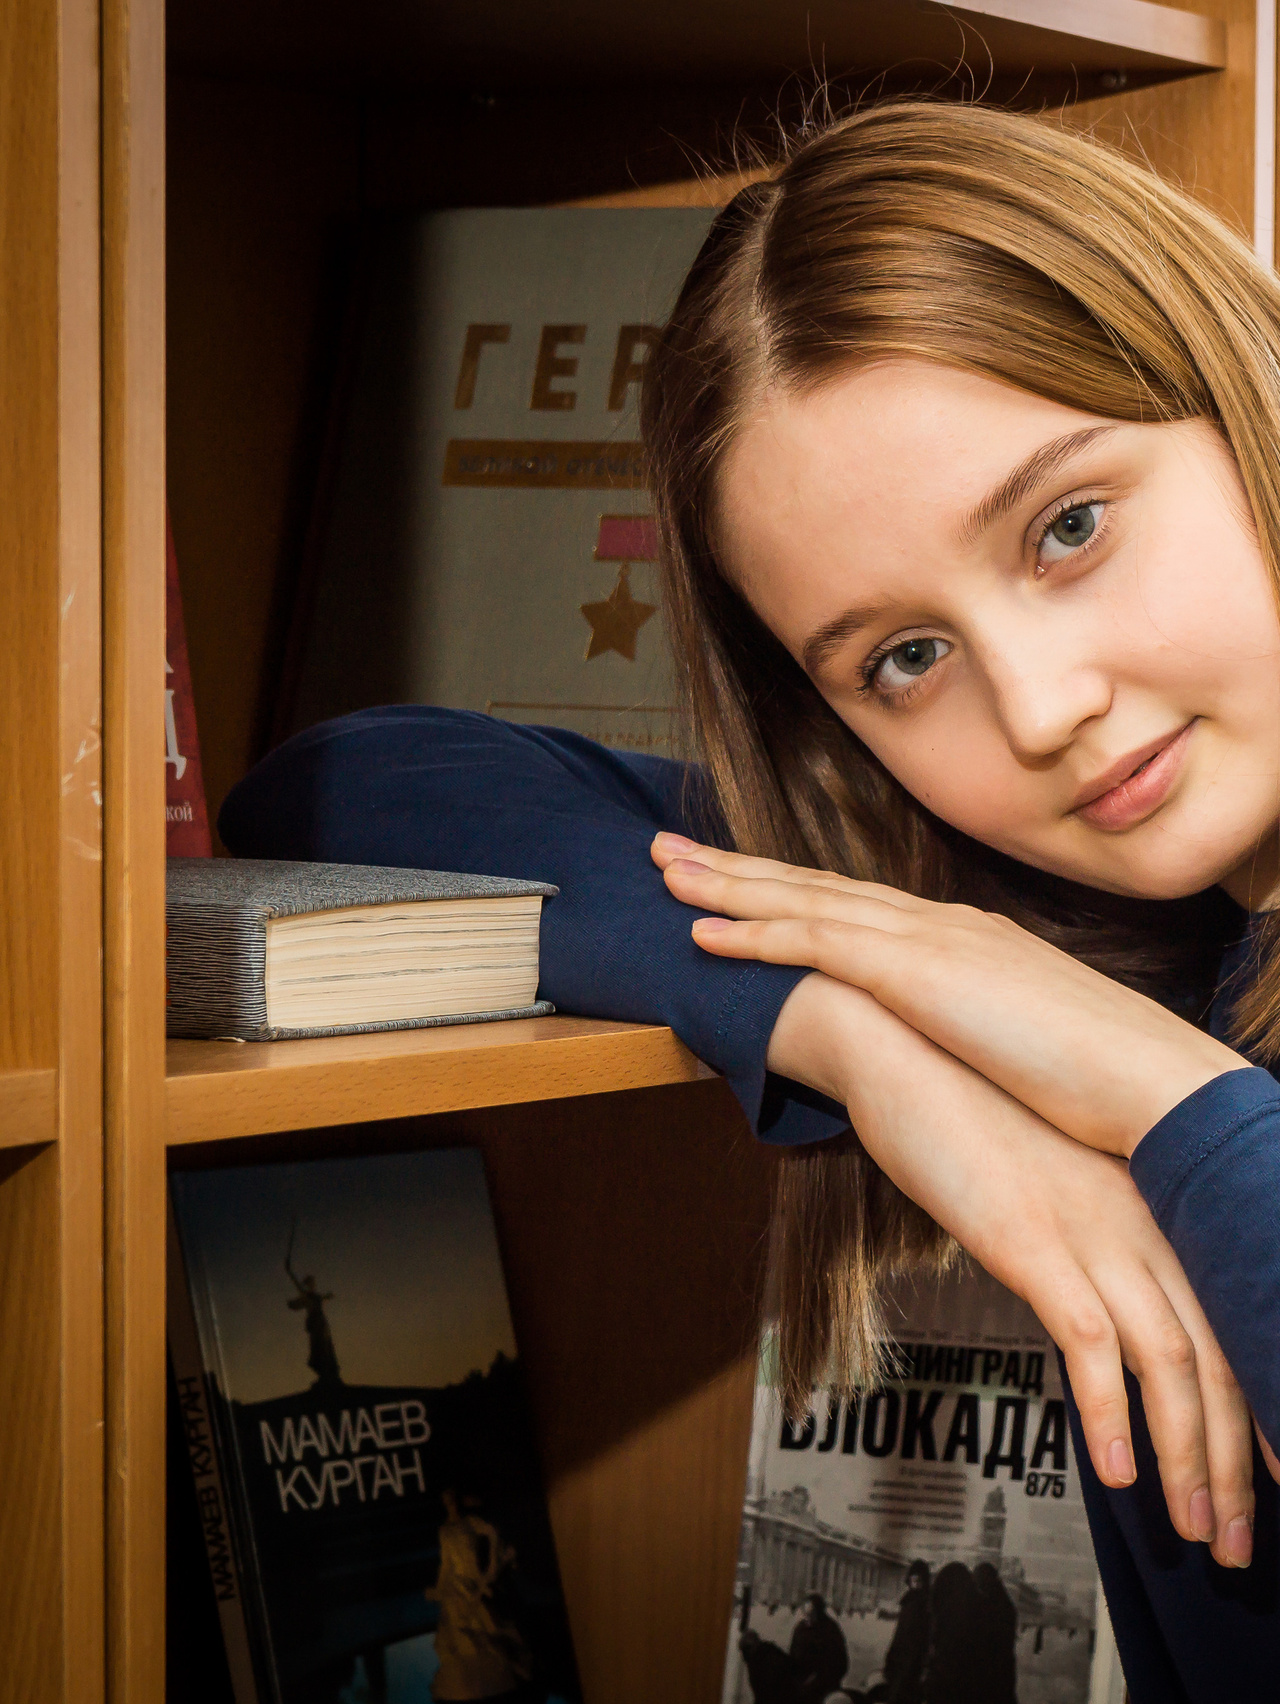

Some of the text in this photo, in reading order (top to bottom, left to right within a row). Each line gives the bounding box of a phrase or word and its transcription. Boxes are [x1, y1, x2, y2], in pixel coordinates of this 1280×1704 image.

[880, 1341, 1045, 1396] ЕНИНГРАД
[178, 1376, 214, 1478] КУРГАН
[259, 1400, 431, 1464] МАМАЕВ
[275, 1449, 426, 1513] КУРГАН
[1024, 1472, 1067, 1499] 875
[199, 1486, 237, 1602] МАМАЕВ
